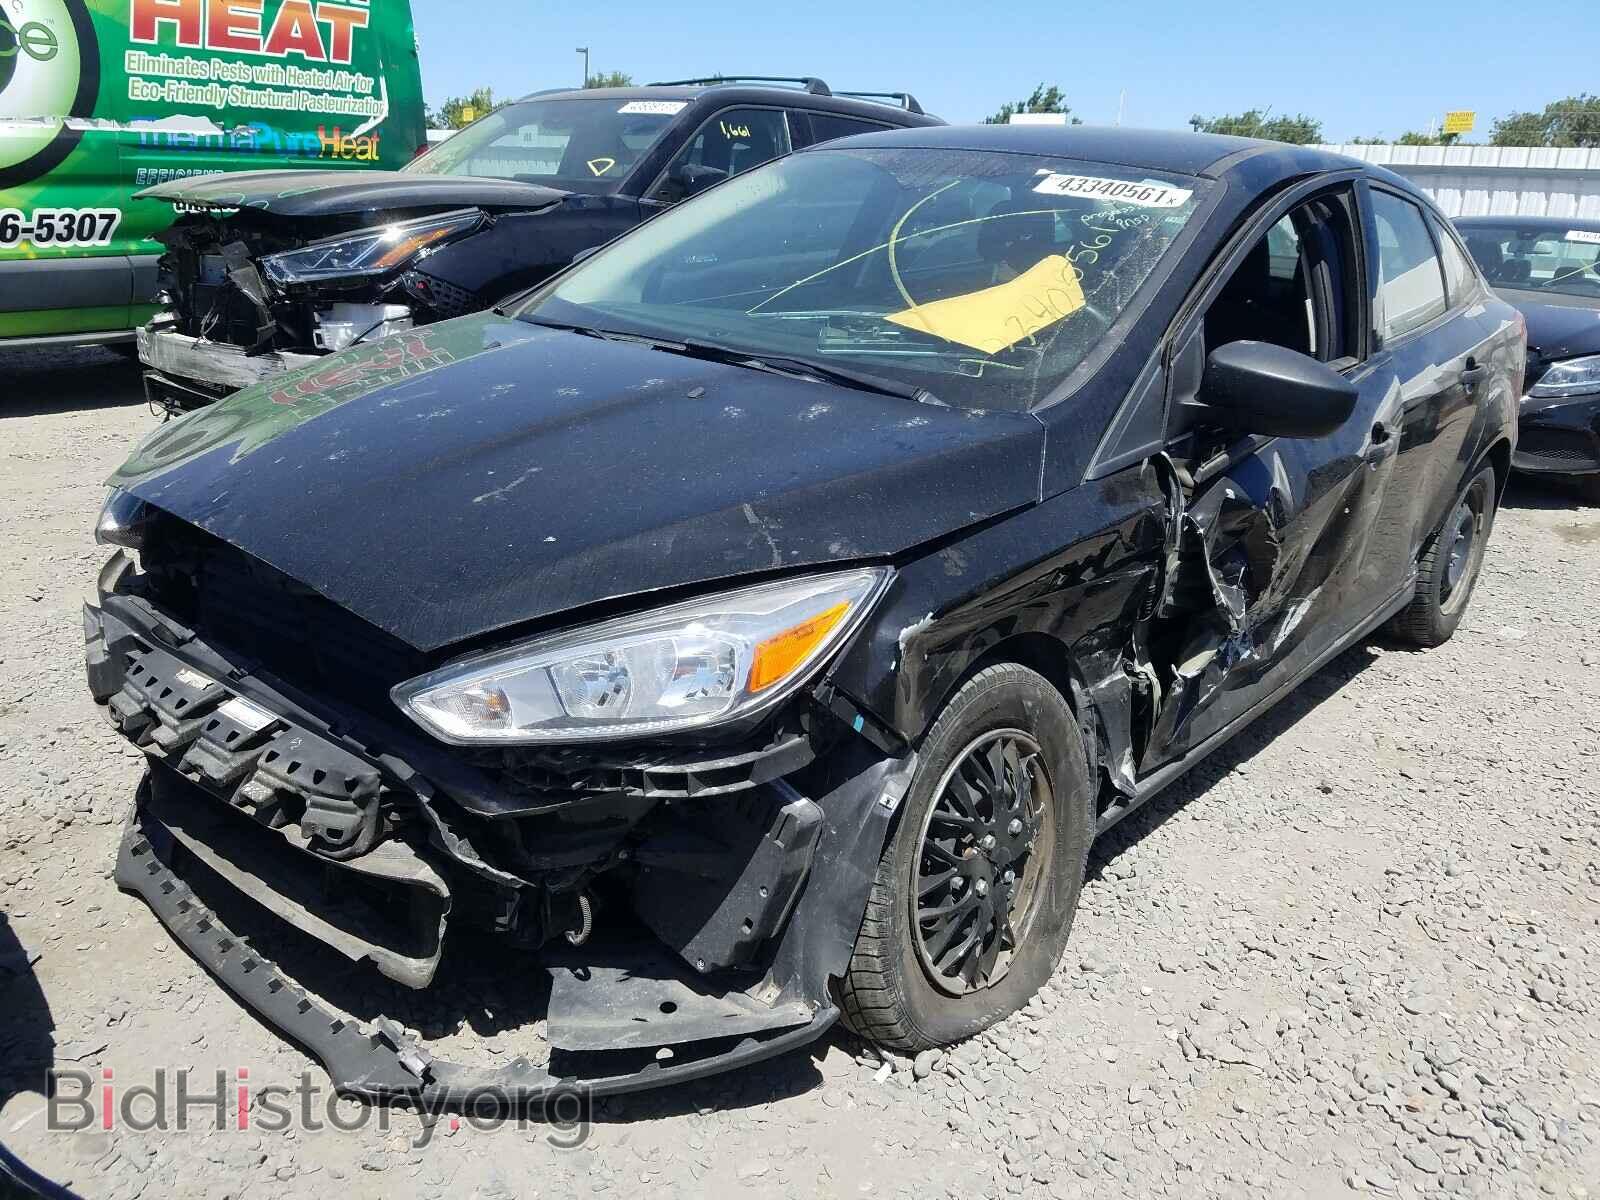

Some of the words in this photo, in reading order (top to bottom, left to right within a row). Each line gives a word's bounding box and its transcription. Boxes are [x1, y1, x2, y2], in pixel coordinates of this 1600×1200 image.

[129, 0, 370, 65] HEAT
[126, 51, 209, 79] Eliminates
[211, 58, 252, 82] Pests
[253, 64, 286, 86] with
[287, 66, 334, 90] Heated
[334, 71, 354, 92] Air
[354, 72, 374, 94] for
[129, 77, 228, 109] Eco-Friendly
[229, 85, 299, 111] Structural
[1056, 177, 1169, 203] 43340561
